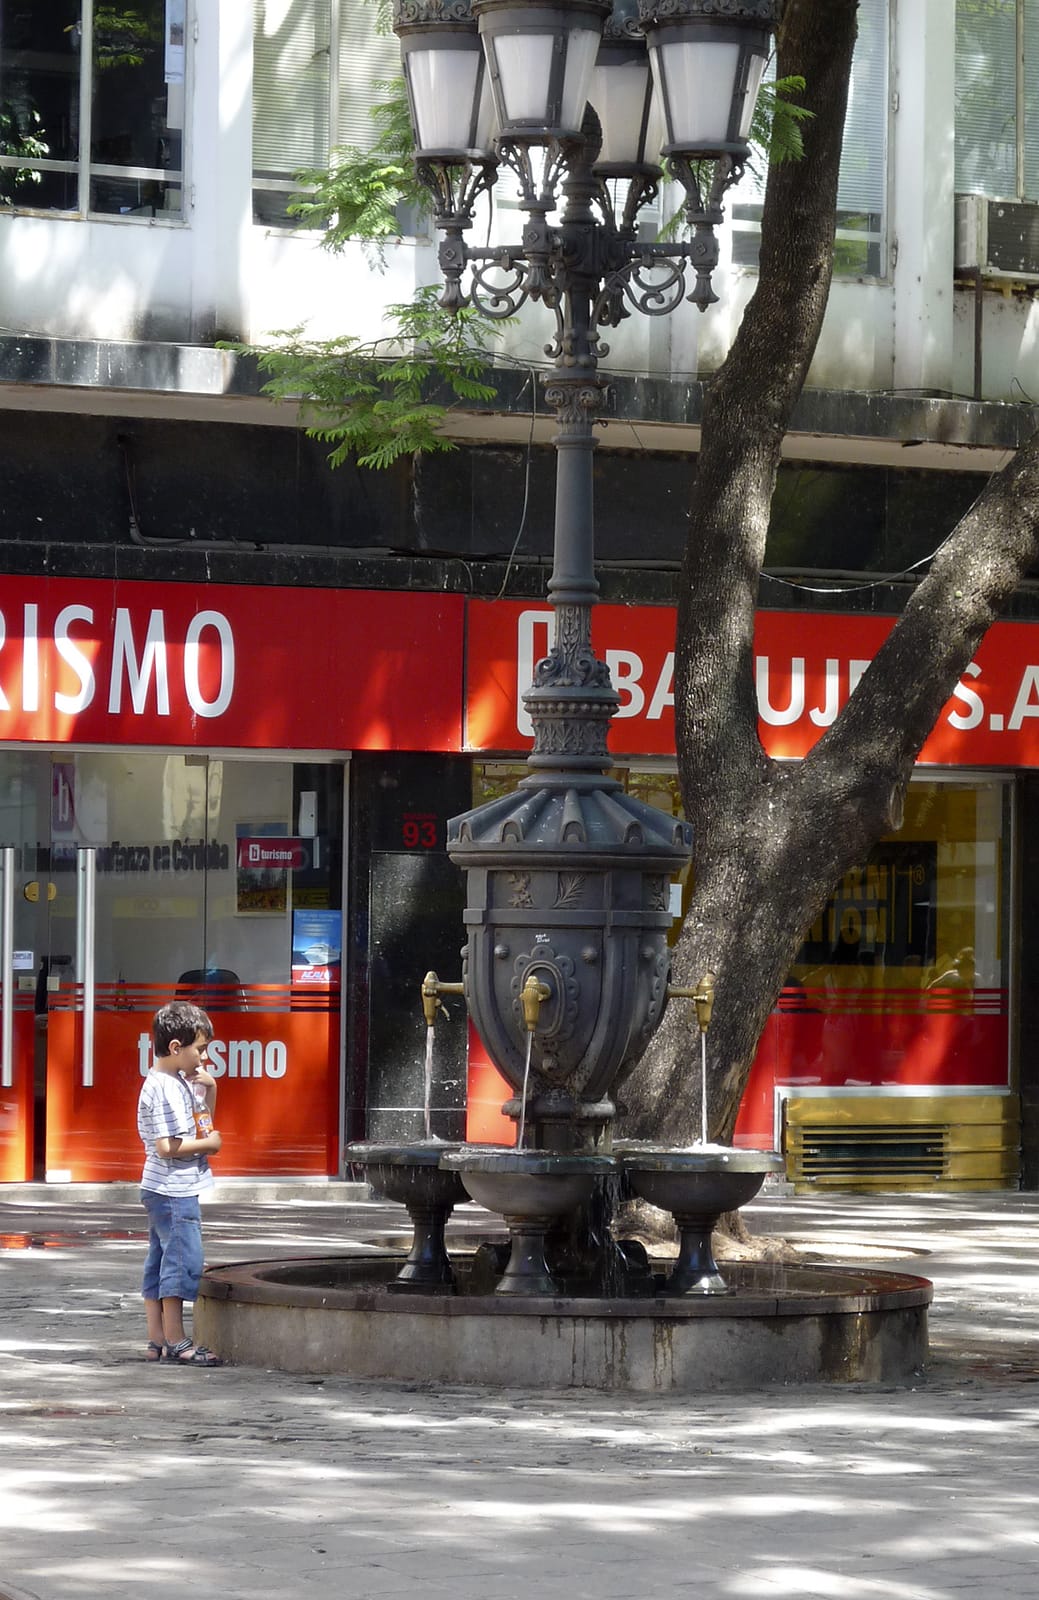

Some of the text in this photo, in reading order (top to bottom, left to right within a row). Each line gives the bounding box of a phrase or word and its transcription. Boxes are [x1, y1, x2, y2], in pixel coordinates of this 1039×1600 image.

[0, 603, 235, 718] ISMO
[402, 821, 438, 849] 93
[261, 848, 293, 861] turismo
[803, 906, 887, 944] NION
[138, 1032, 287, 1079] tsmo
